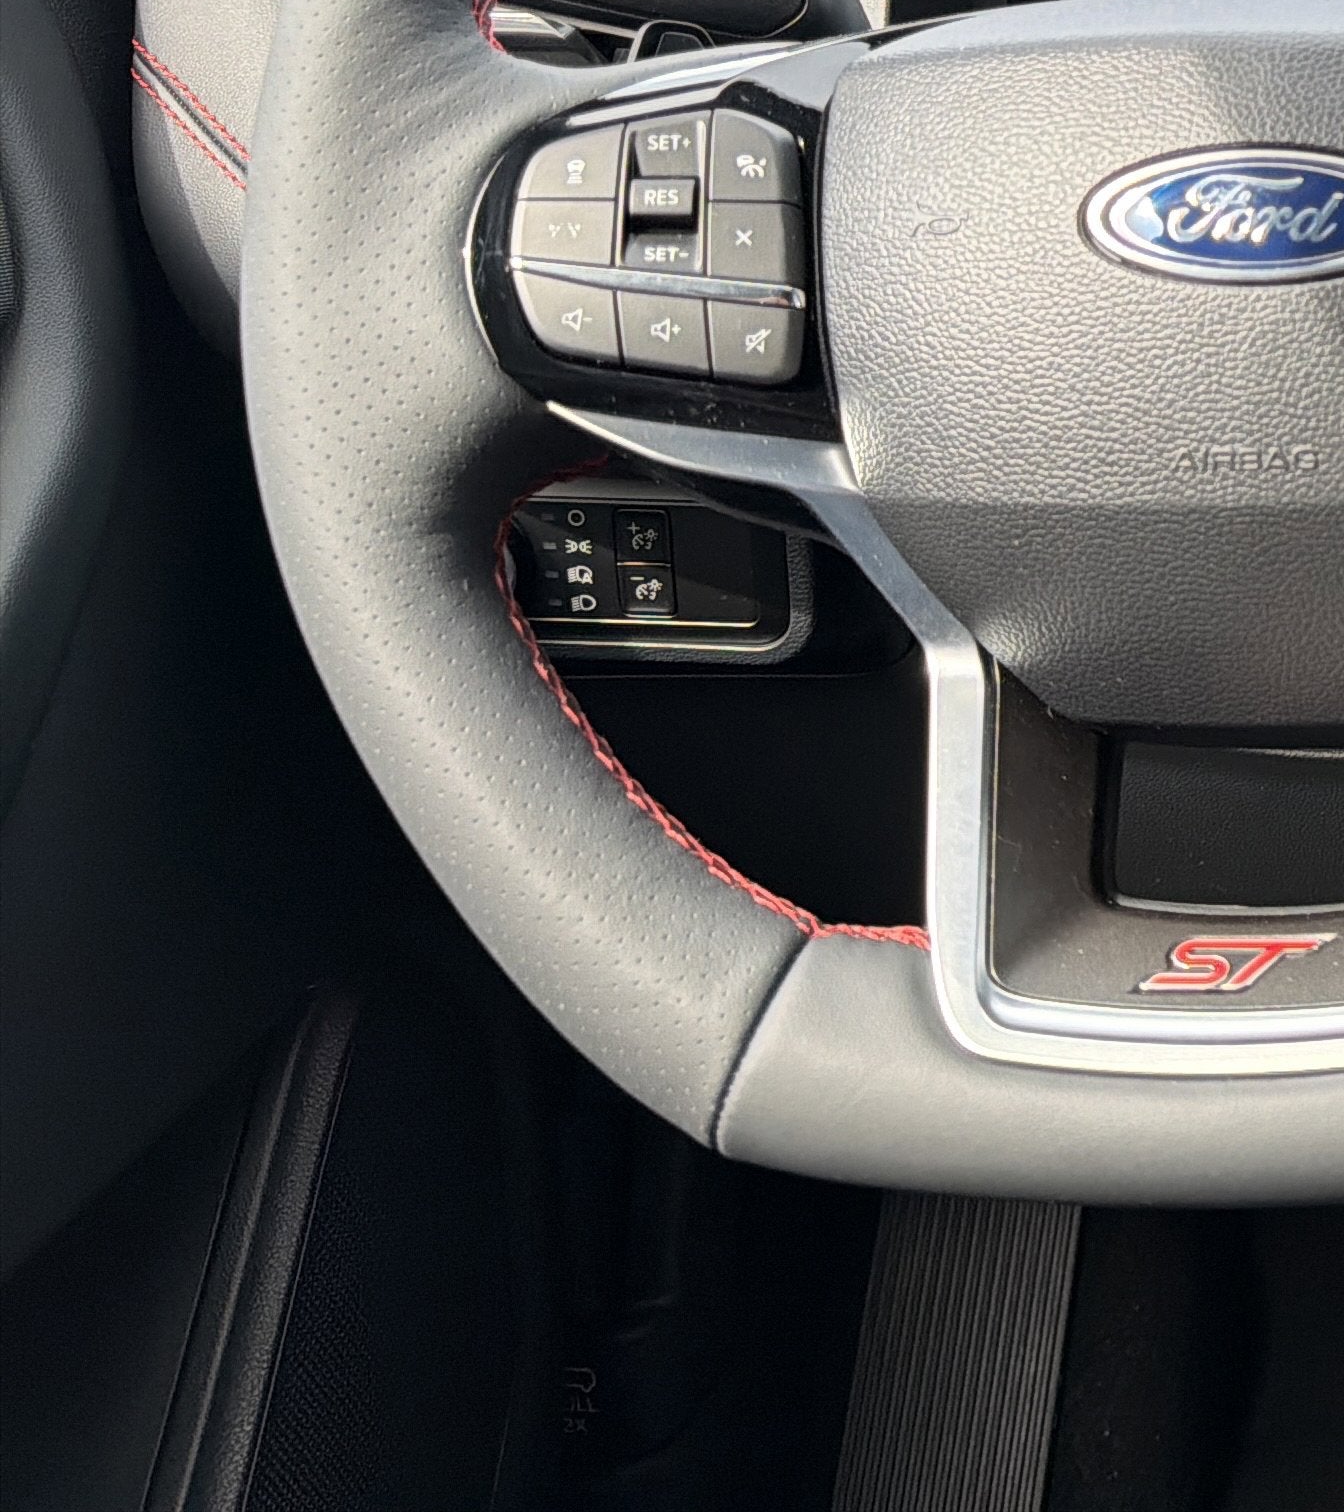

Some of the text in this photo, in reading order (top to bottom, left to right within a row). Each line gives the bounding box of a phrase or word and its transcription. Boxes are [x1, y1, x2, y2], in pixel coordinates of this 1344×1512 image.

[647, 134, 692, 152] SET+
[644, 189, 678, 206] RES
[1167, 175, 1344, 245] Ford
[644, 247, 689, 262] SET-
[1170, 443, 1320, 473] AIRBAG
[1138, 932, 1339, 993] ST
